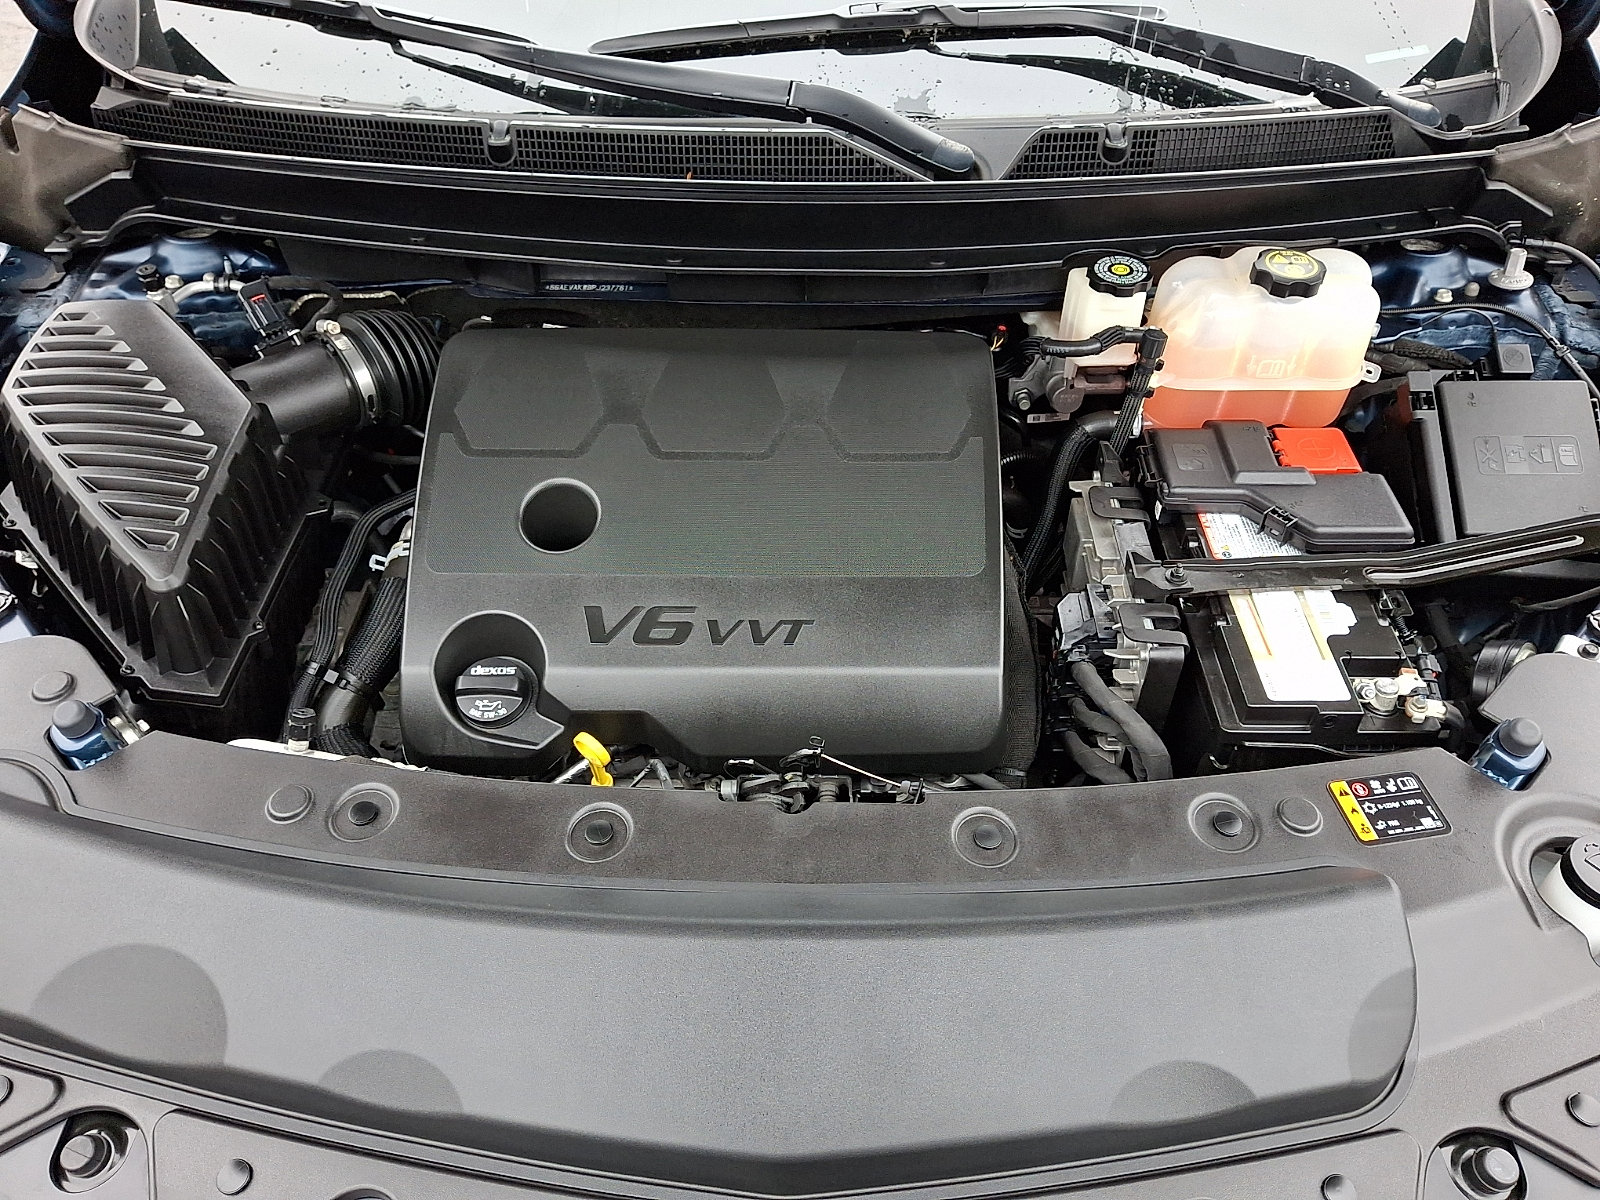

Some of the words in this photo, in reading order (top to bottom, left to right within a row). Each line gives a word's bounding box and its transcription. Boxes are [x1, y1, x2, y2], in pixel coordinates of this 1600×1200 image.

[583, 605, 699, 646] V6
[706, 619, 816, 646] VVT
[470, 665, 518, 676] dexos
